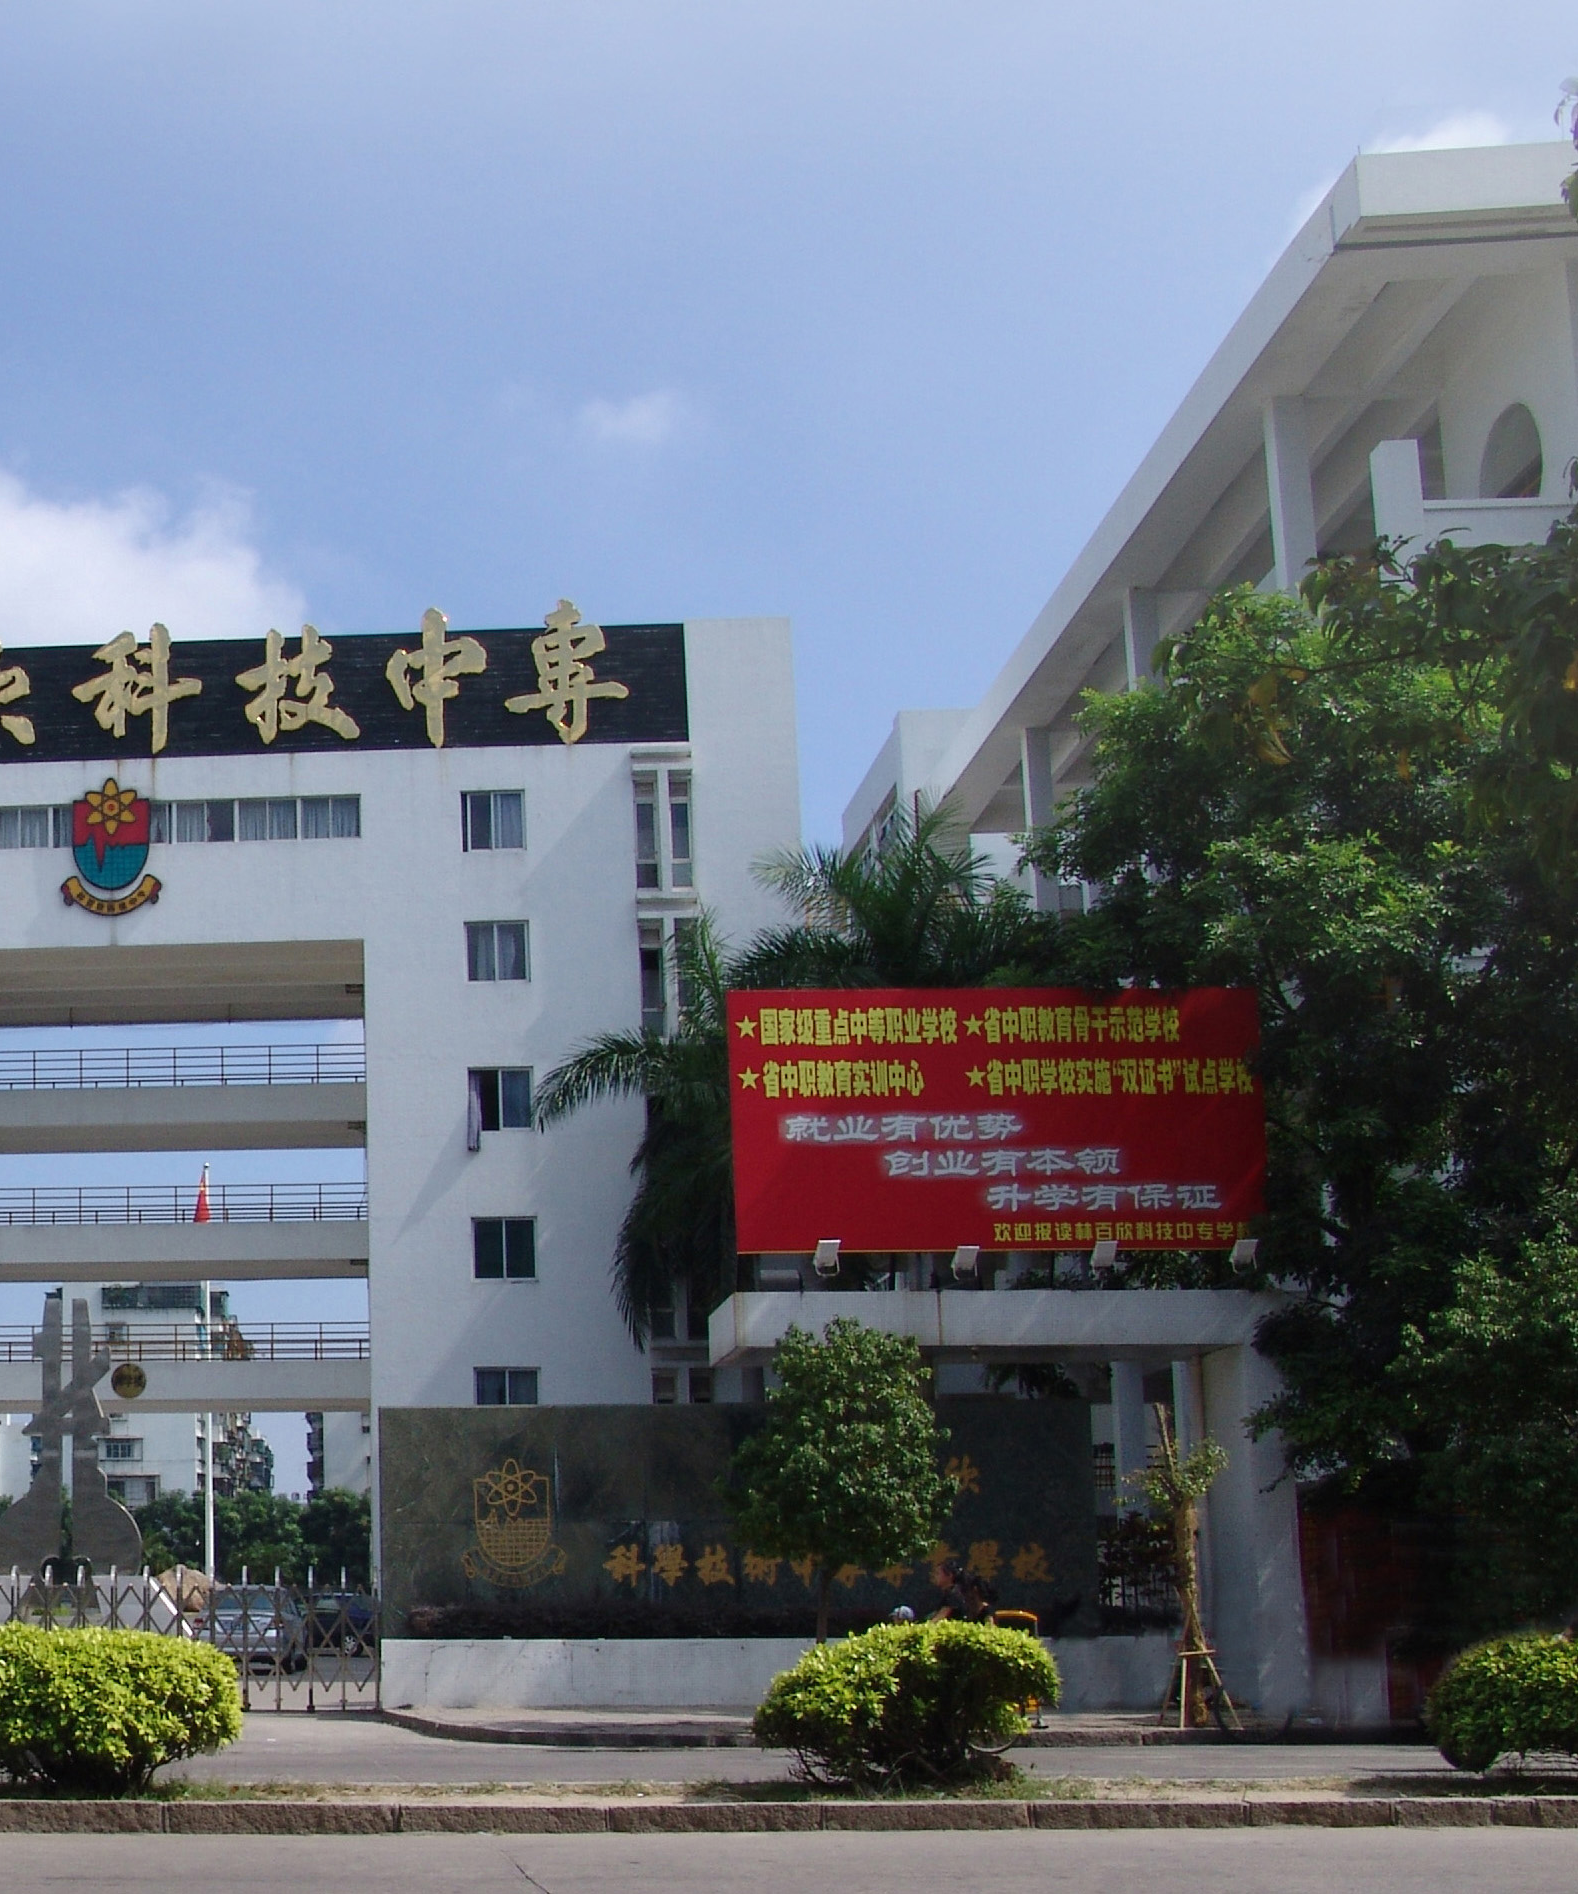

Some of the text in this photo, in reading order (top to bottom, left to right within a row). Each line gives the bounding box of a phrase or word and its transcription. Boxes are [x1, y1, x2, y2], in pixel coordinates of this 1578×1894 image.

[760, 1008, 957, 1045] 国家级重点中等职业学校
[984, 1006, 1180, 1043] 省中职教育骨干示范学校
[763, 1060, 925, 1098] 省中职教育实训中心
[785, 1112, 1022, 1143] 就业有优势
[884, 1147, 1120, 1177] 创业有本领
[987, 1183, 1221, 1212] 升学有保证
